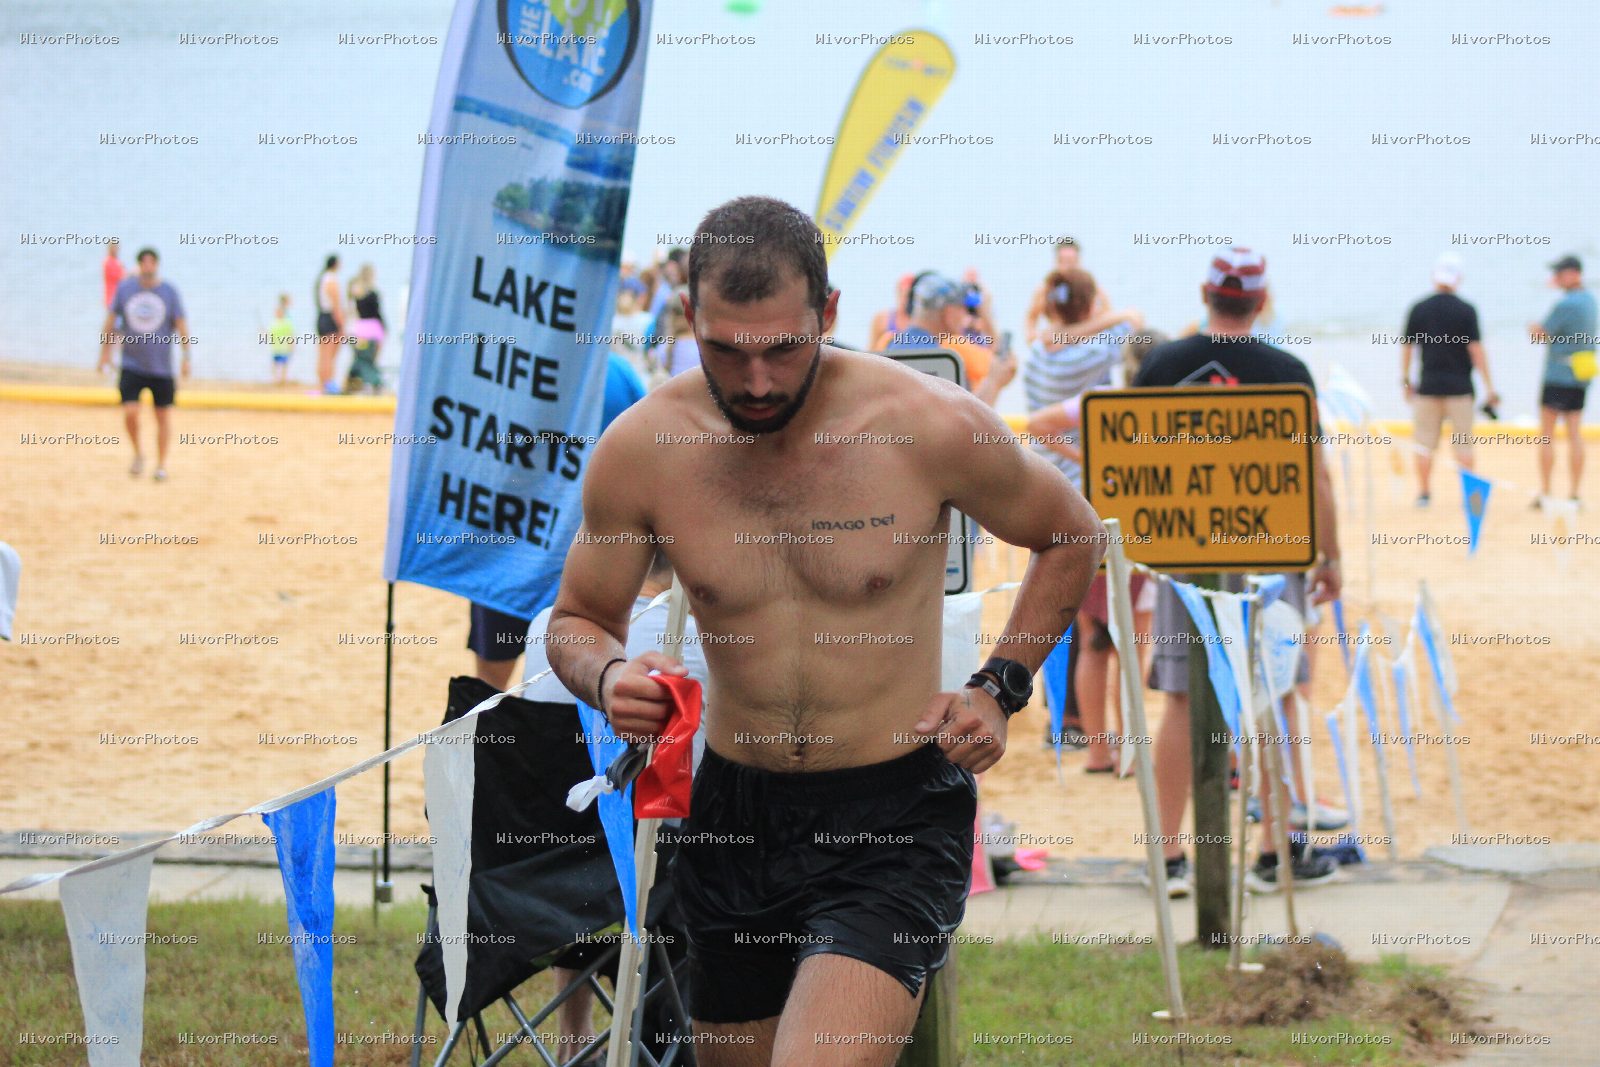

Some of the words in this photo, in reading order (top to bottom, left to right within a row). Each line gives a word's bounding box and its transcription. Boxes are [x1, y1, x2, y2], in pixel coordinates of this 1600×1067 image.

[472, 256, 577, 332] LAKE
[473, 333, 559, 402] LIFE
[430, 396, 585, 481] STARTS
[1101, 410, 1138, 443] NO
[1152, 407, 1298, 443] LIFEGUARD
[439, 473, 560, 550] HERE!
[1101, 464, 1173, 498] SWIM
[1186, 465, 1216, 496] AT
[1228, 463, 1300, 496] YOUR
[1133, 508, 1196, 540] OWN
[1208, 505, 1271, 538] RISK
